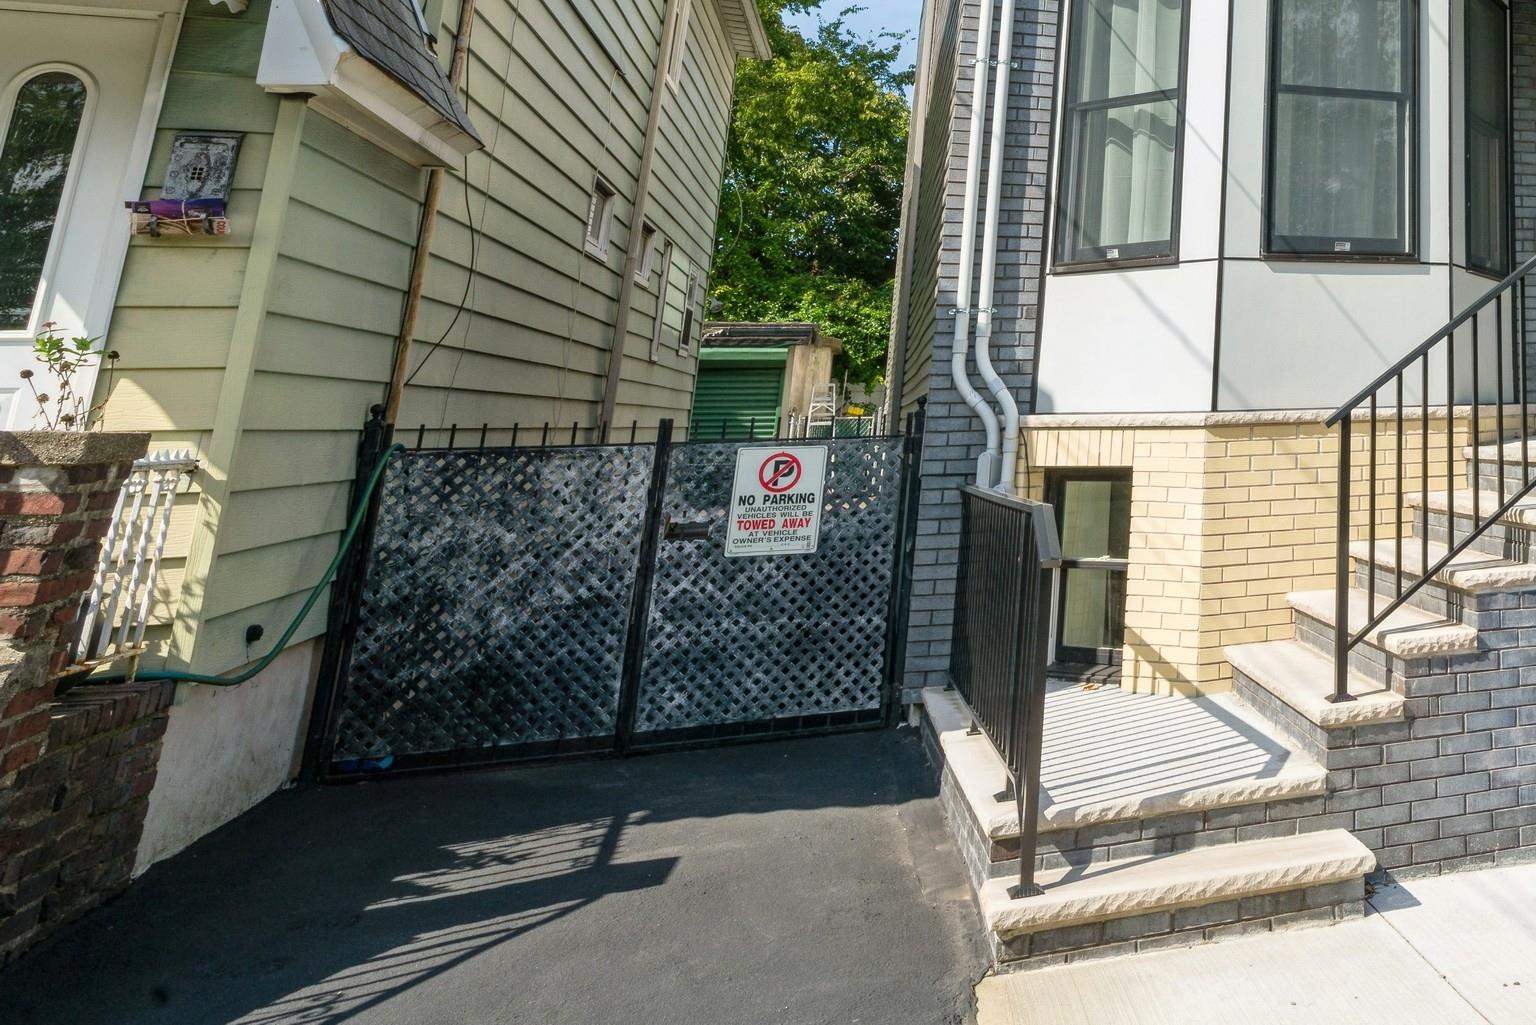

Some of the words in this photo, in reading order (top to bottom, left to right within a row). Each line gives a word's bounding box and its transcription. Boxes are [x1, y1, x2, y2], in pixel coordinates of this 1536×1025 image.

[738, 495, 756, 506] NO
[763, 492, 815, 506] PARKING
[745, 504, 807, 513] UNAUTHORIZED
[737, 512, 777, 520] VEHICLES
[737, 519, 776, 531] TOWED
[781, 517, 812, 529] AWAY
[762, 529, 798, 537] VEHICLE
[732, 536, 772, 545] OWNER'S
[773, 534, 812, 543] EXPENSE
